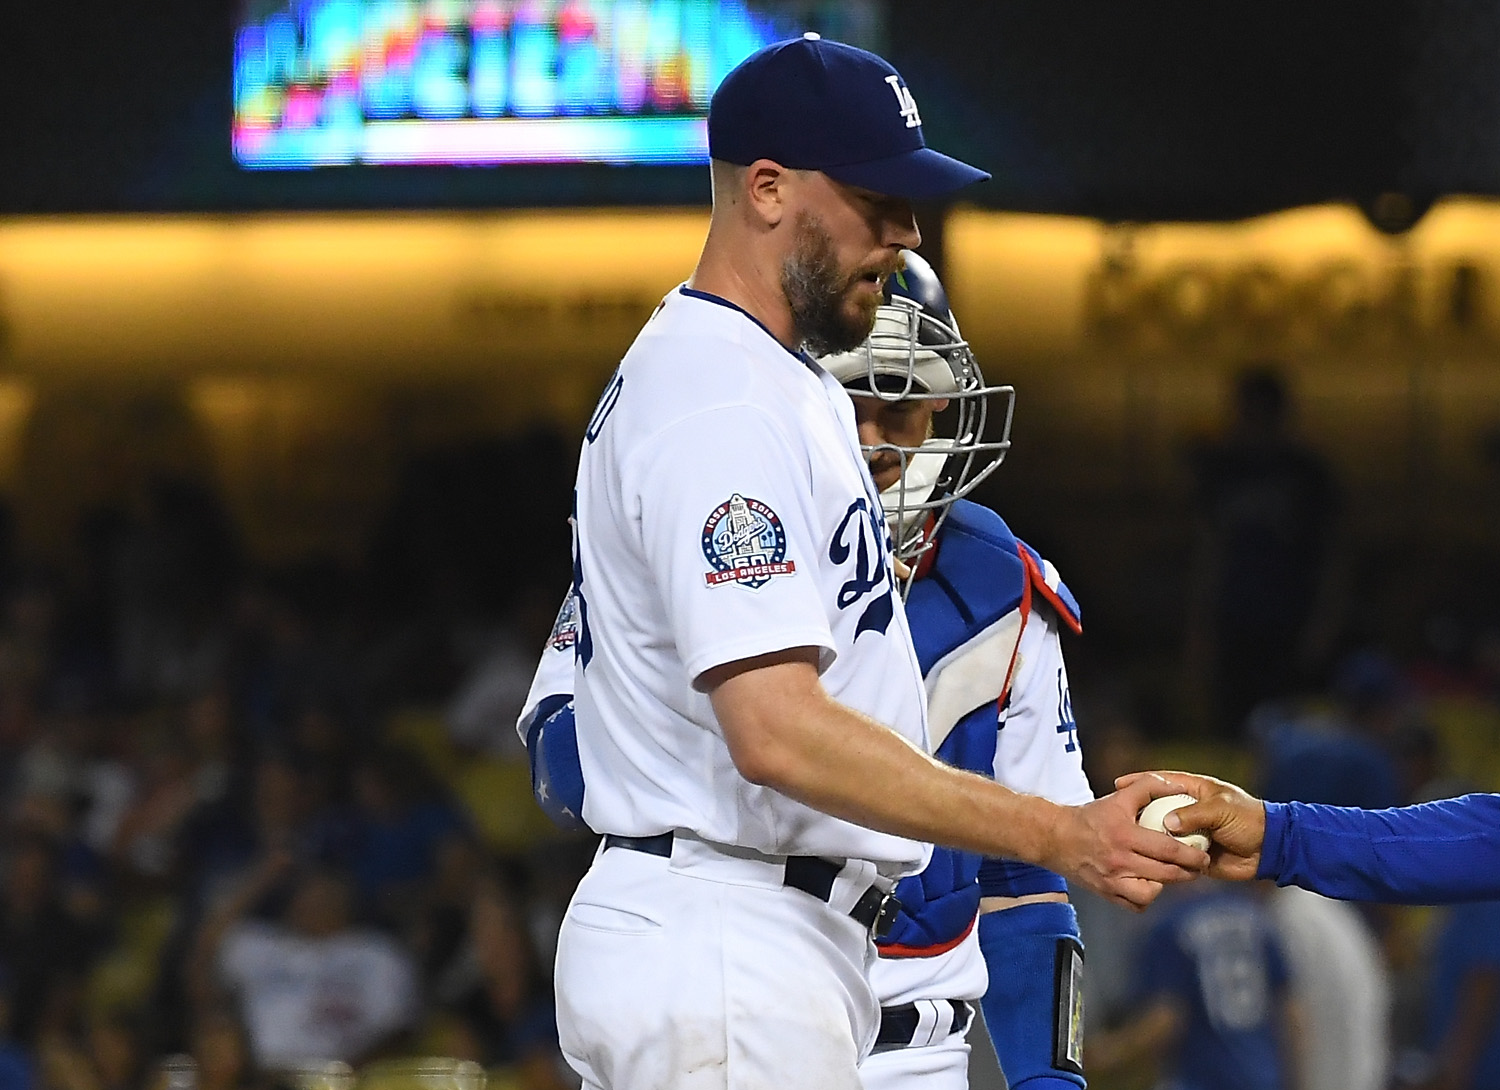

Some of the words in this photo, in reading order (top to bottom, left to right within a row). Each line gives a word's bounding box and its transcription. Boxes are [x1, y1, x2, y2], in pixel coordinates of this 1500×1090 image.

[885, 75, 922, 128] LA
[717, 516, 767, 550] Dodgers
[715, 571, 736, 582] LOS
[740, 564, 787, 576] ANGELES
